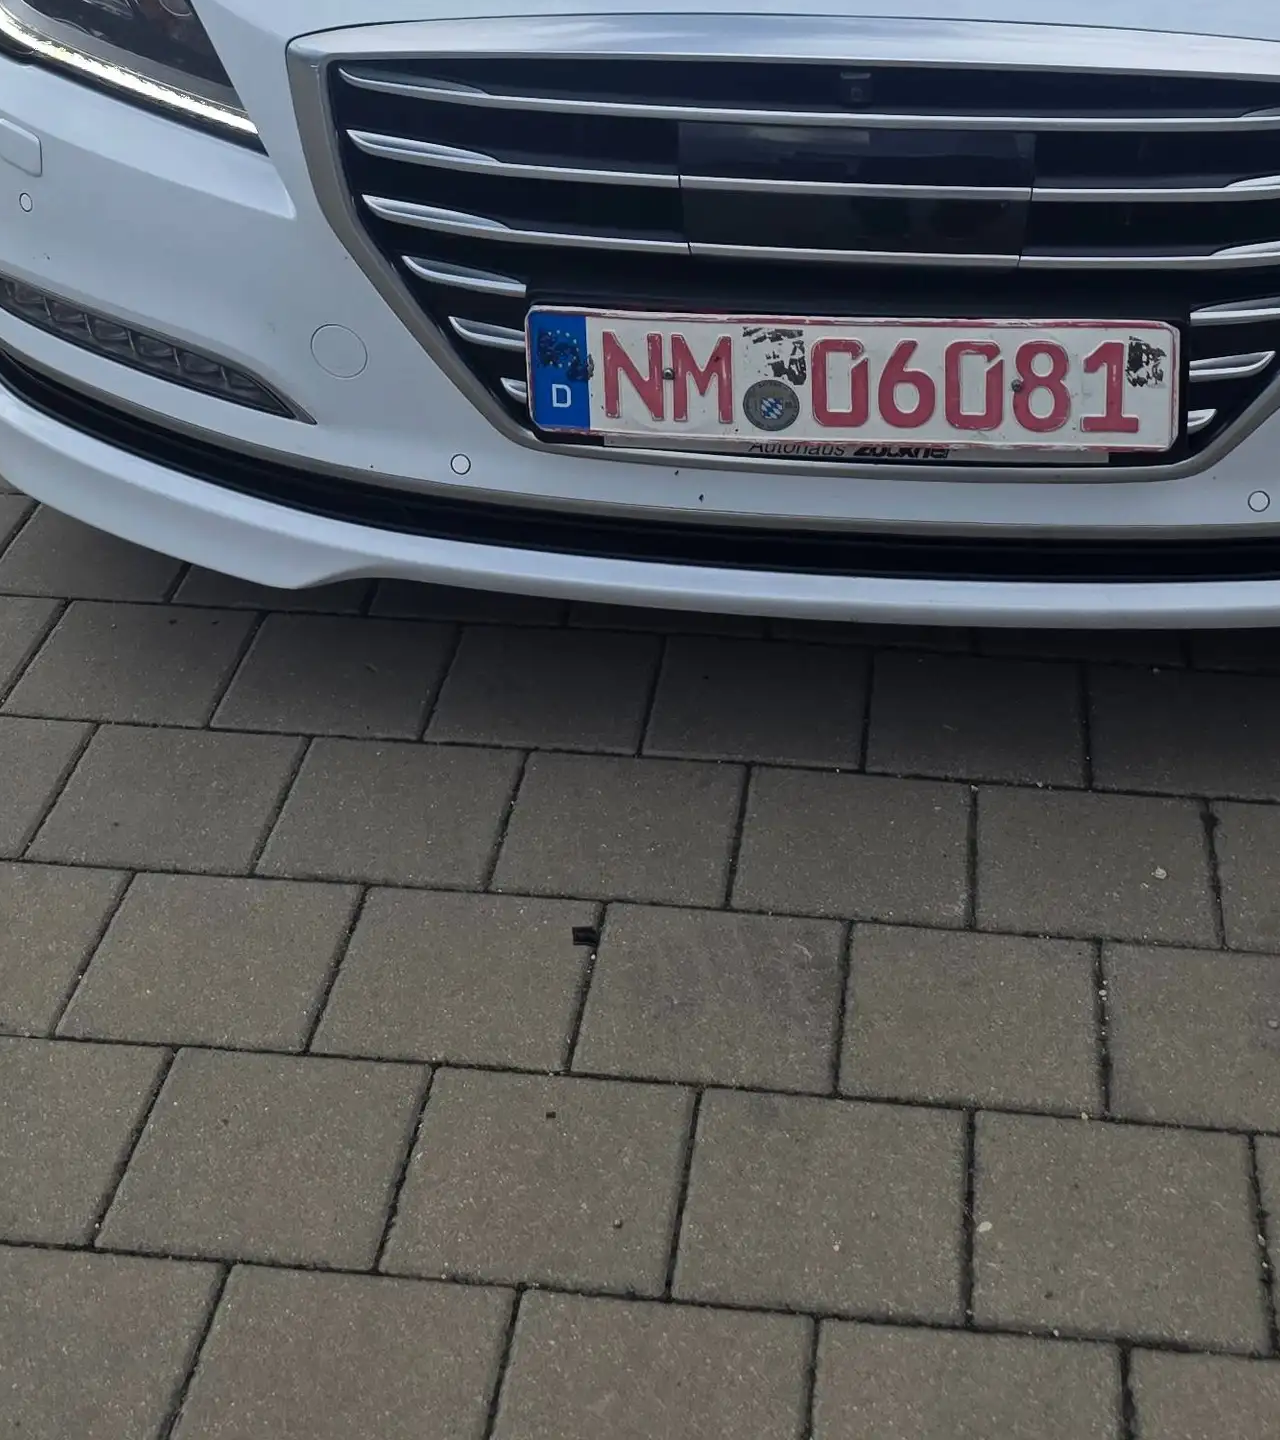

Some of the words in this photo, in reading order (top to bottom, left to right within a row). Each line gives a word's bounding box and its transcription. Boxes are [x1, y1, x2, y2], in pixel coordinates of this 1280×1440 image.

[551, 383, 572, 408] D
[600, 329, 734, 424] NM
[811, 337, 1140, 434] 06081
